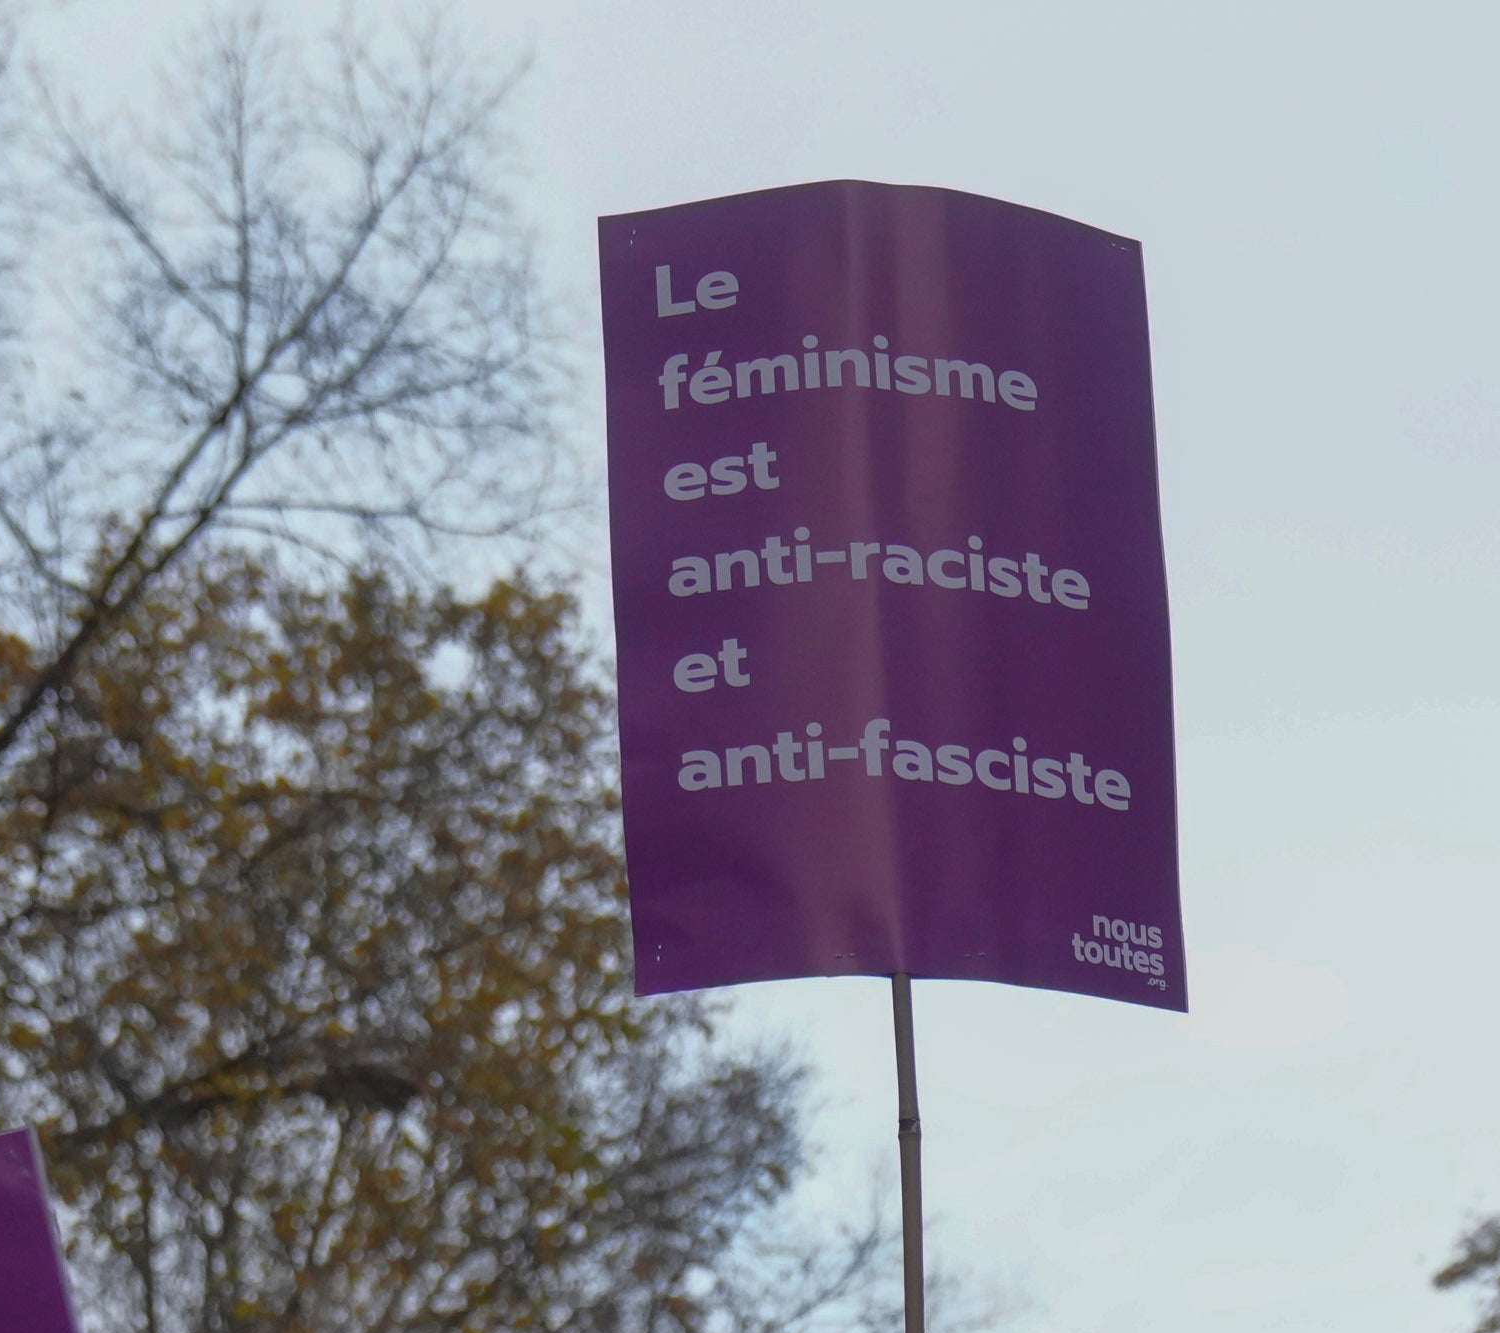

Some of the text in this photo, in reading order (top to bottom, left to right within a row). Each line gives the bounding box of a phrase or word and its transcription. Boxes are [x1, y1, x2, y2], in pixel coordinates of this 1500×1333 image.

[654, 263, 740, 318] Le
[658, 334, 1038, 411] féminisme
[663, 441, 780, 501] est
[667, 526, 1091, 609] anti-raciste
[672, 637, 751, 693] et
[678, 718, 1132, 811] anti-fasciste
[1071, 932, 1165, 976] toutes
[1092, 914, 1163, 949] nous
